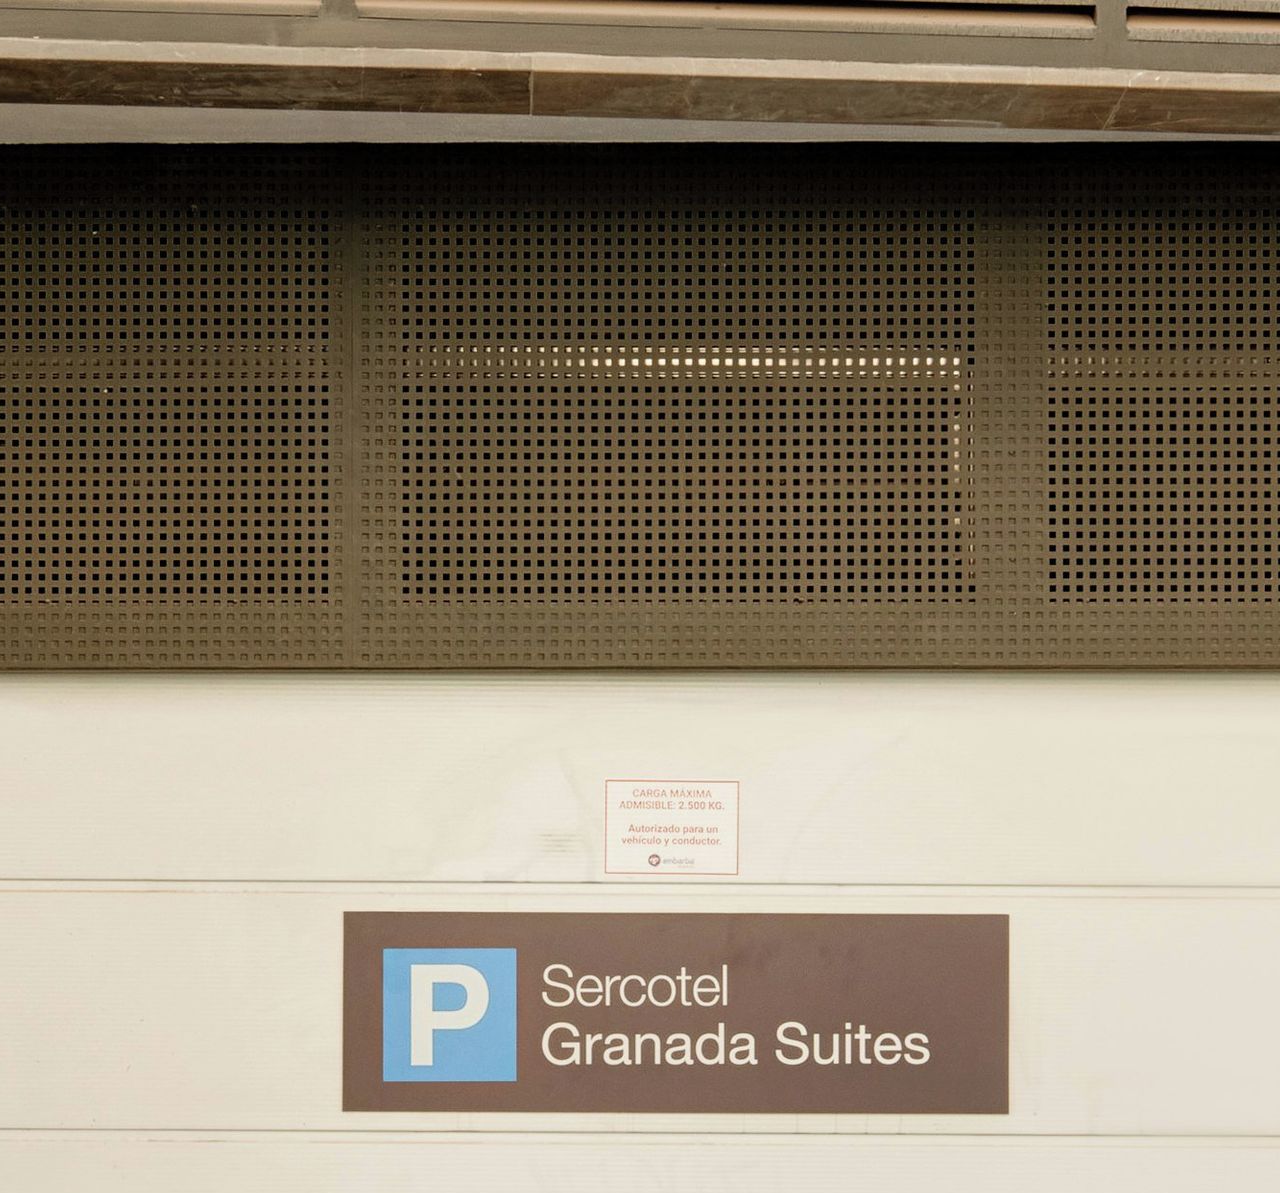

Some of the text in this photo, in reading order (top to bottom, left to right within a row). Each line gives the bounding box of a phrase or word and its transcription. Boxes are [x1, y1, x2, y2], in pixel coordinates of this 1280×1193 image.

[632, 789, 667, 798] CARGA
[619, 800, 725, 810] ADMISIBLE: 2.500 KG.
[628, 824, 719, 835] Autorizado para un
[621, 836, 722, 846] vehículo y conductor.
[541, 963, 729, 1007] Sercotel
[410, 964, 490, 1067] P
[540, 1021, 932, 1066] Granada Suites
